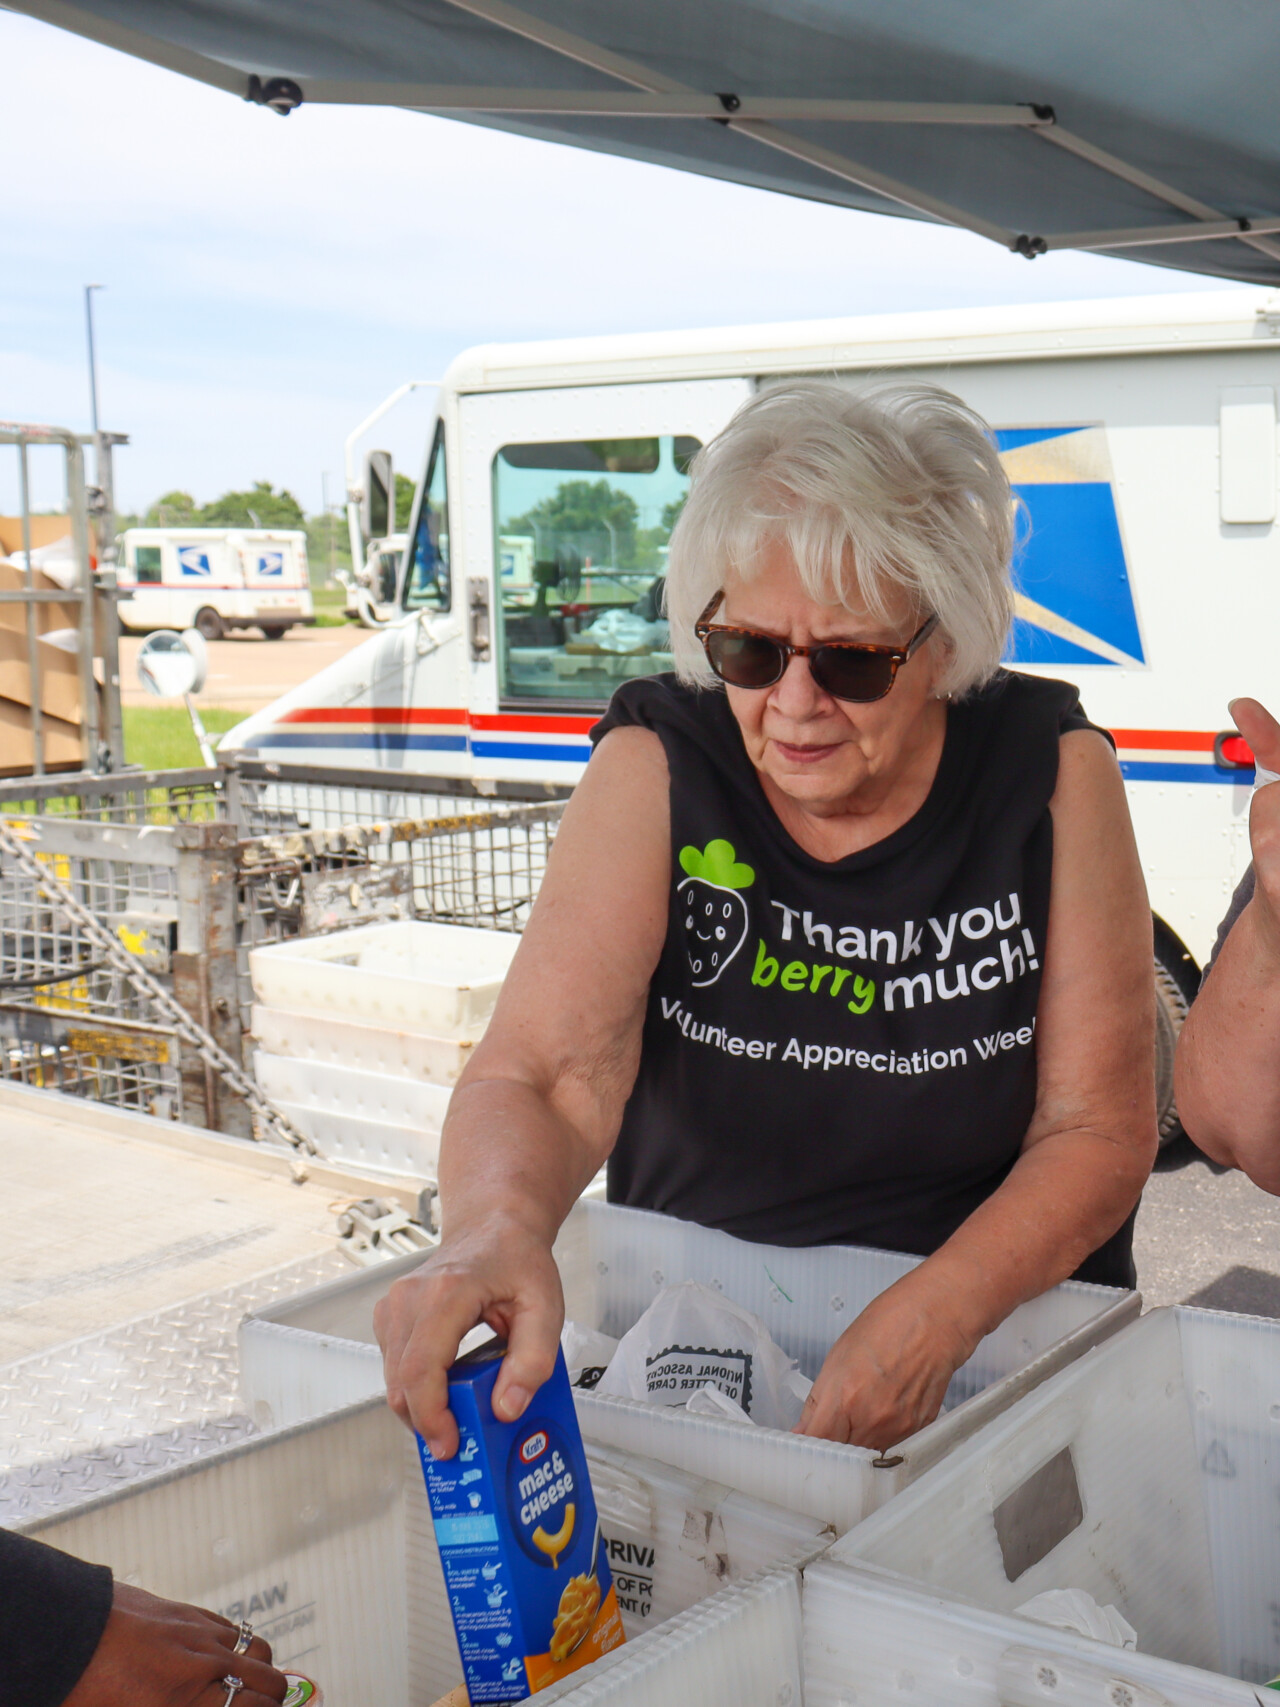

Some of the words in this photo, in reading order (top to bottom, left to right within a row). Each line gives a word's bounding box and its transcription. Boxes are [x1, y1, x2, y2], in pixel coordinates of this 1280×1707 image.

[771, 900, 923, 965] Thank
[928, 893, 1021, 961] you
[751, 938, 876, 1014] berry
[884, 928, 1039, 1011] much!
[782, 1038, 967, 1076] Appreciation
[973, 1016, 1036, 1061] Wee
[519, 1461, 553, 1500] mac
[552, 1450, 565, 1475] &
[525, 1438, 543, 1457] Kraft
[617, 1577, 636, 1592] OF
